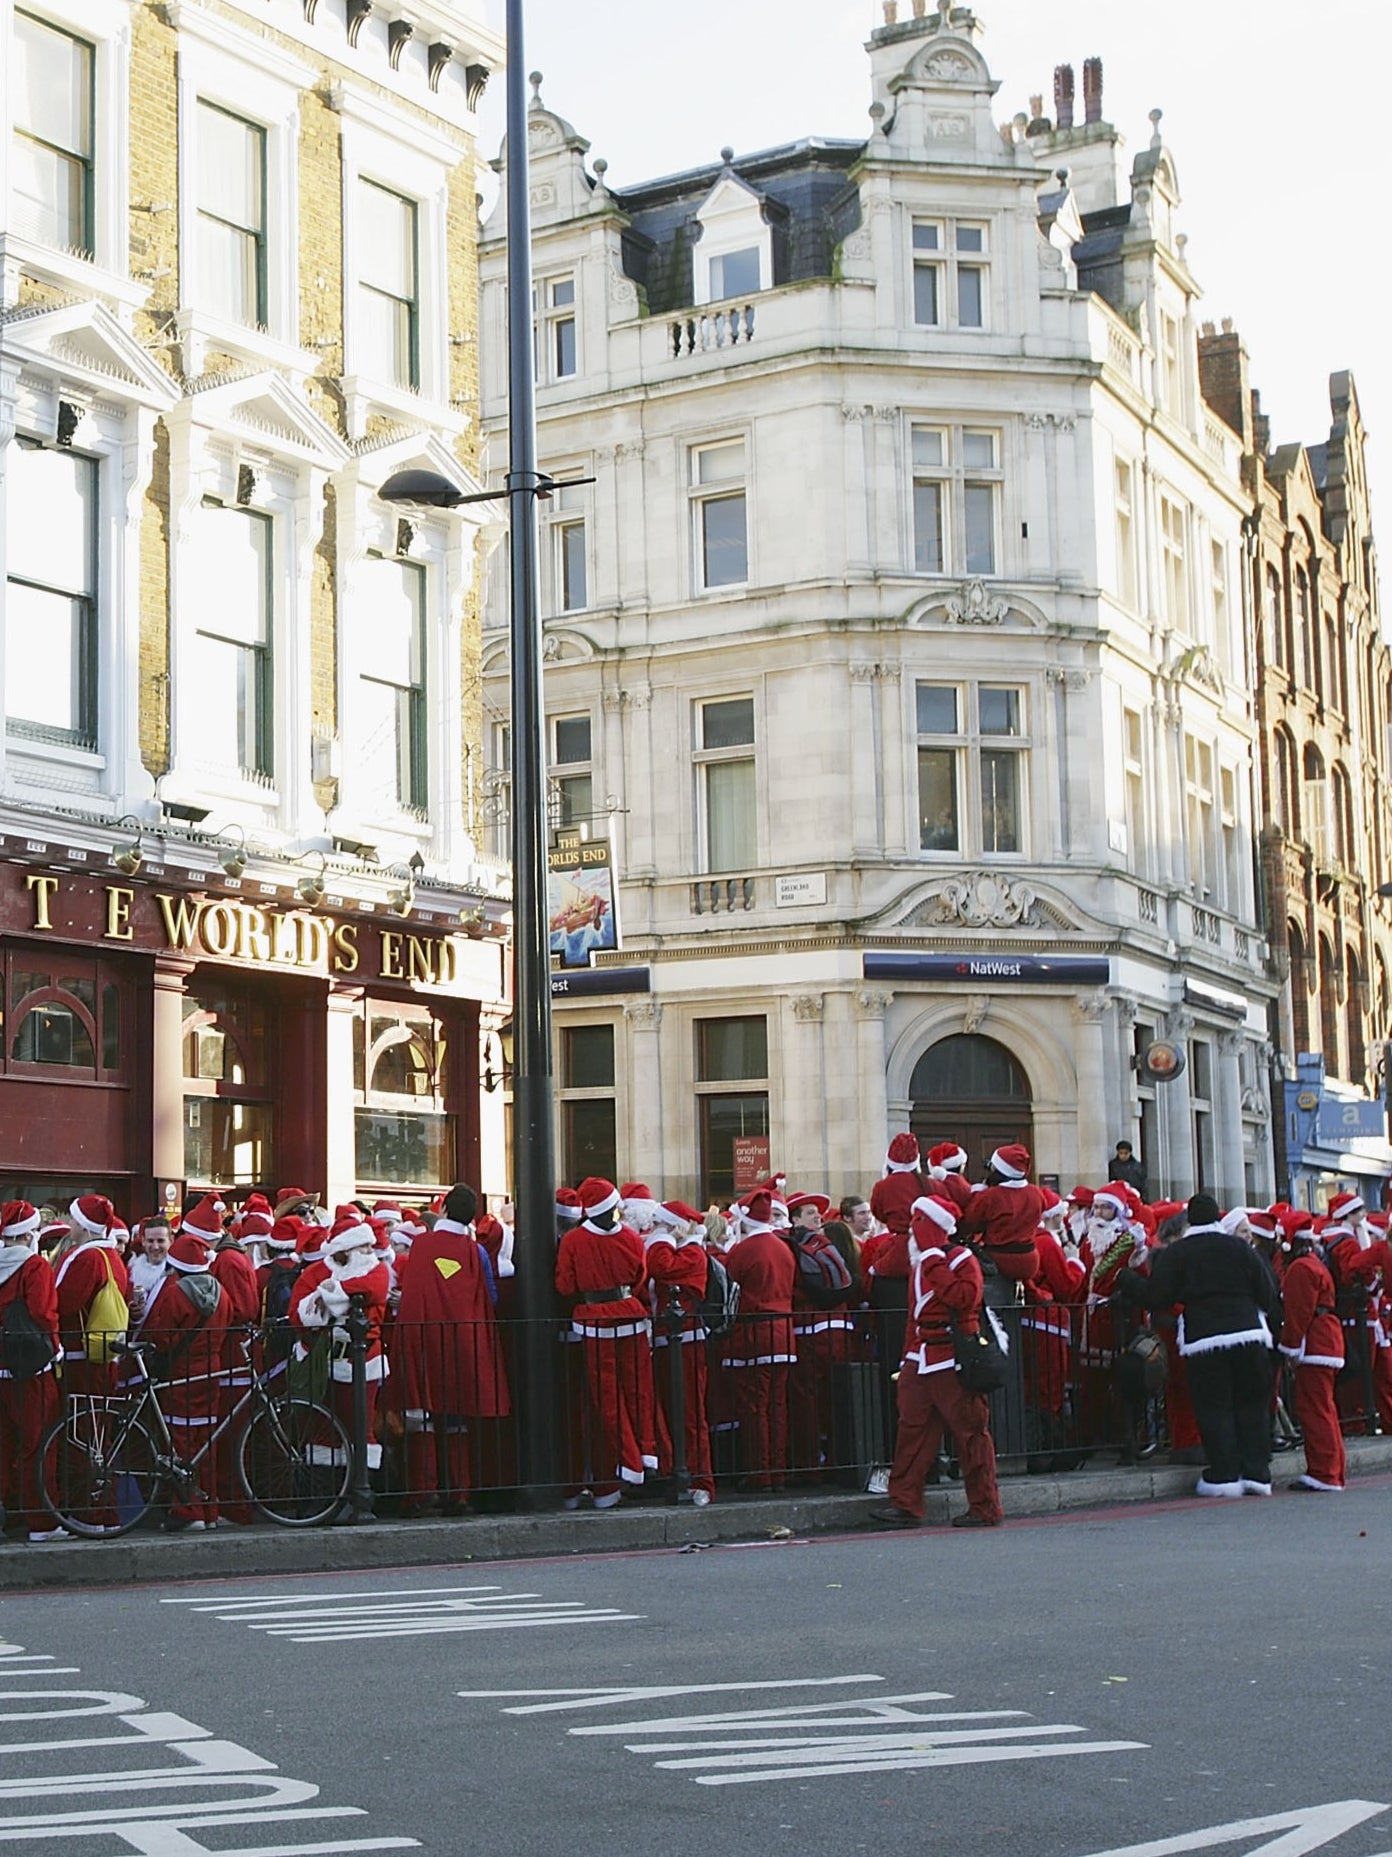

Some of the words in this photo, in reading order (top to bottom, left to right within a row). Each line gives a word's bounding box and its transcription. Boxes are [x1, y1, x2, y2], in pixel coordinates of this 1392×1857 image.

[558, 837, 579, 849] THE
[548, 851, 579, 866] ORLD'S
[583, 849, 606, 861] END
[155, 894, 359, 972] WORLD'S
[379, 930, 457, 985] END
[970, 961, 1021, 975] NatWest
[736, 1145, 768, 1155] another
[737, 1156, 754, 1165] way
